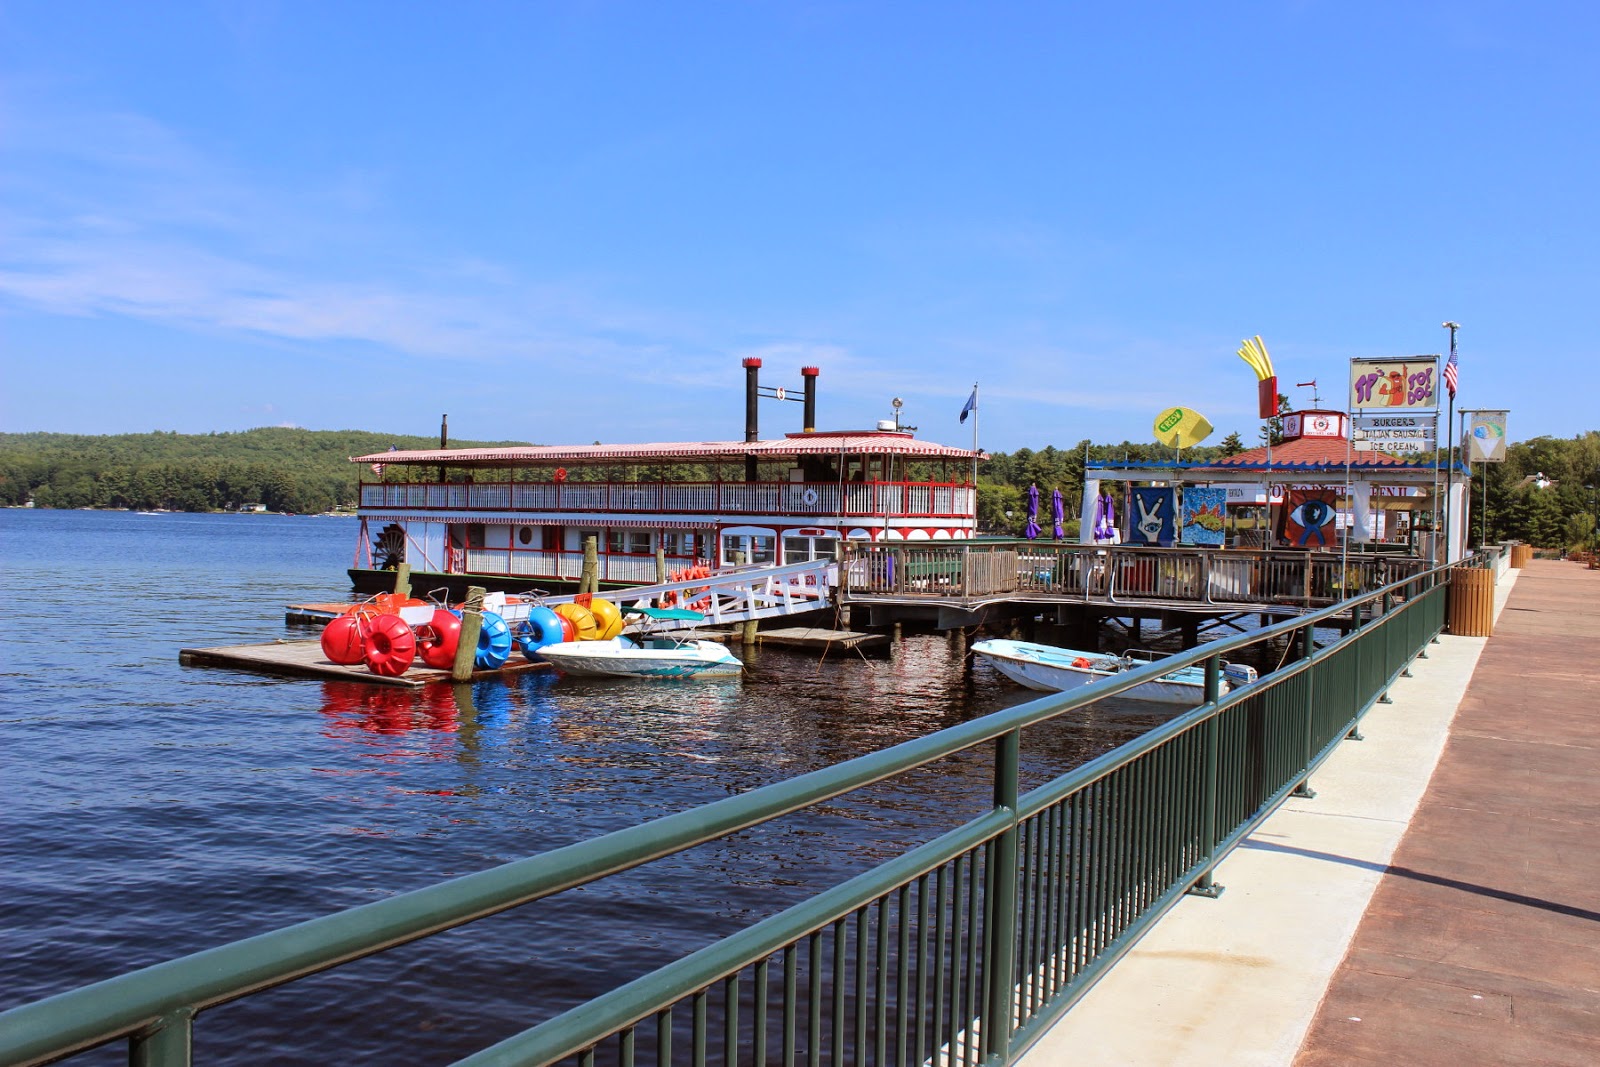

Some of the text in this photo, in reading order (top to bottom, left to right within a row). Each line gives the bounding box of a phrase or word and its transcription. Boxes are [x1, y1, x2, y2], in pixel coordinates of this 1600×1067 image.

[1408, 367, 1433, 390] TOP
[1408, 384, 1432, 405] DOG
[1160, 411, 1181, 430] FRESH
[1373, 418, 1415, 426] BURGERS
[1362, 429, 1428, 439] ITALIAN SAUSAGE
[1370, 442, 1419, 451] ICE CREAM
